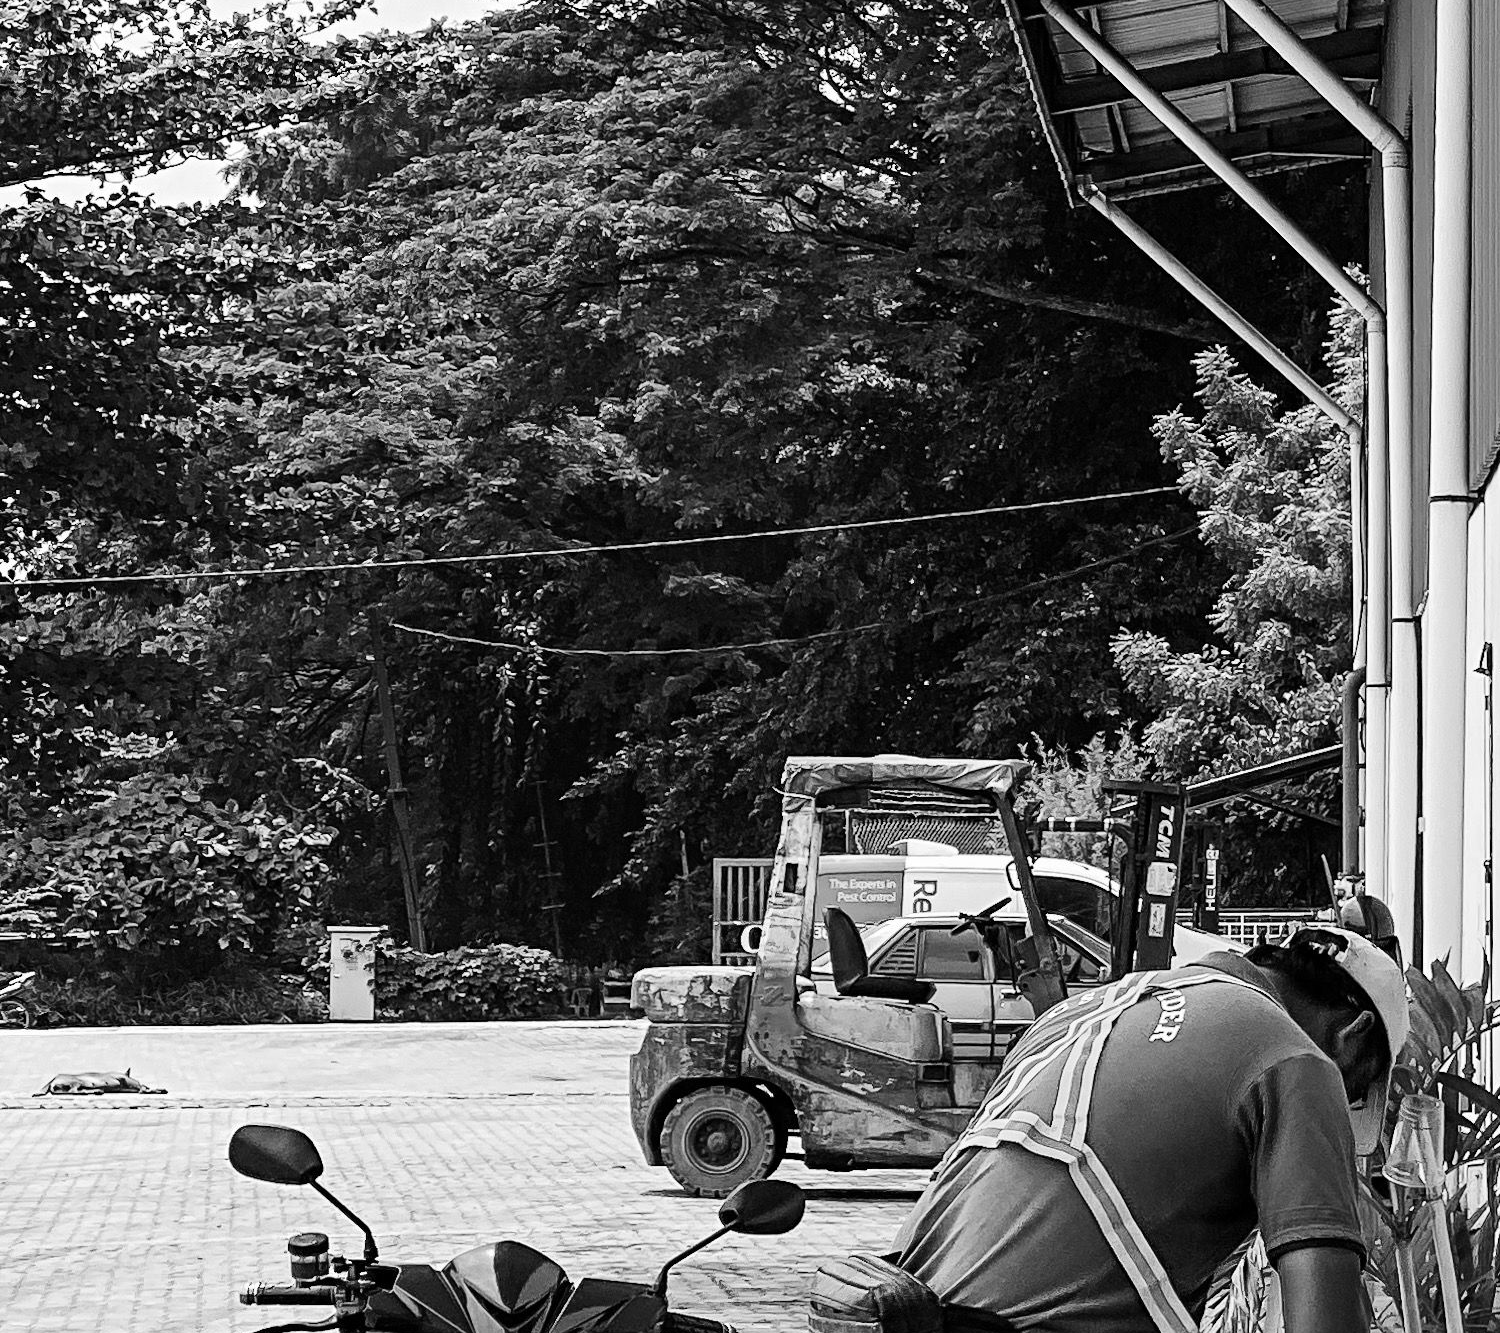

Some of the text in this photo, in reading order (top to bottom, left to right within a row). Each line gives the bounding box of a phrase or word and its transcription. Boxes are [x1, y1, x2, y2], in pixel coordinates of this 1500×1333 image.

[1155, 805, 1176, 859] TCM
[828, 878, 897, 891] The Experts in
[837, 891, 897, 903] Pest Control
